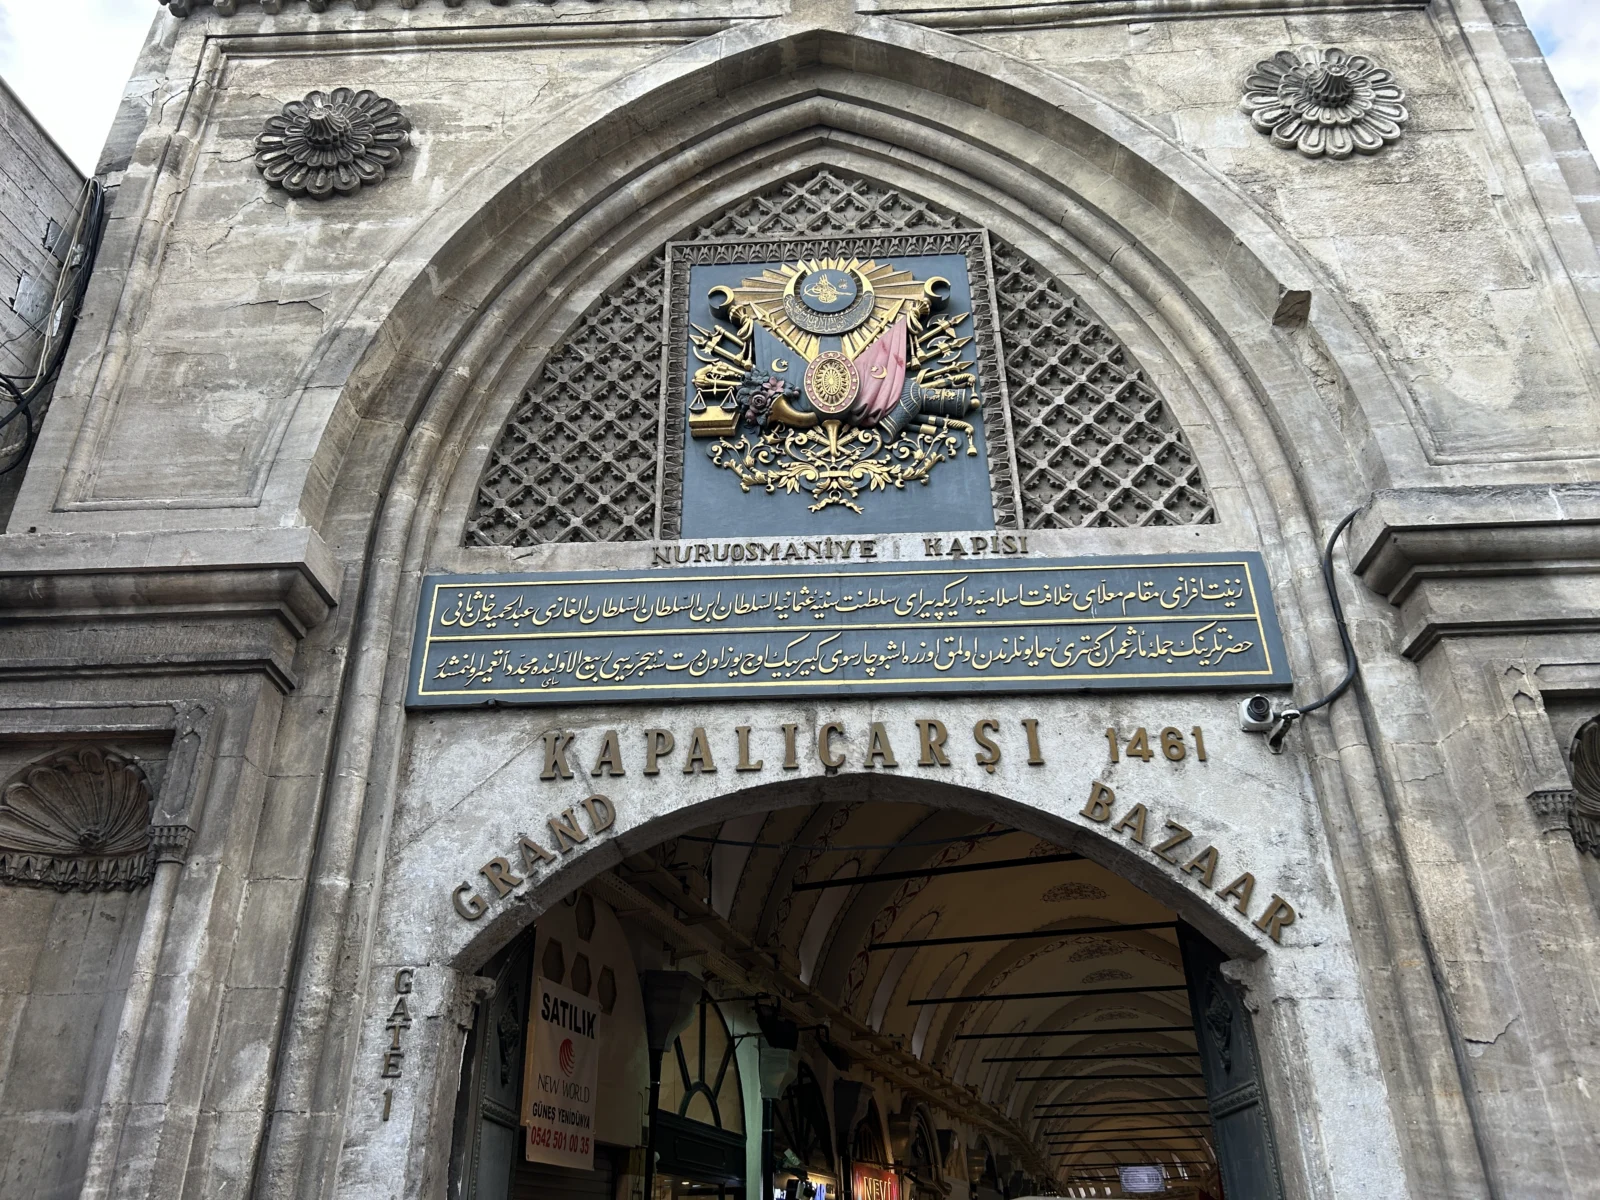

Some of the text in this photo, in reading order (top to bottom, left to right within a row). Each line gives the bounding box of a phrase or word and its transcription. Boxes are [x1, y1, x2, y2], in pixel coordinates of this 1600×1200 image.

[651, 535, 1029, 565] NURUOSMANİYE KAPISI
[540, 723, 799, 780] KAPALI
[1104, 725, 1207, 763] 1461
[452, 781, 1296, 944] GRAND BAZAAR
[541, 992, 597, 1039] SATILIK
[381, 967, 414, 1121] GATE 1
[537, 1073, 590, 1104] NEW WORLD
[532, 1101, 556, 1124] GÜNEŞ
[530, 1126, 590, 1155] 0542 501 00 35
